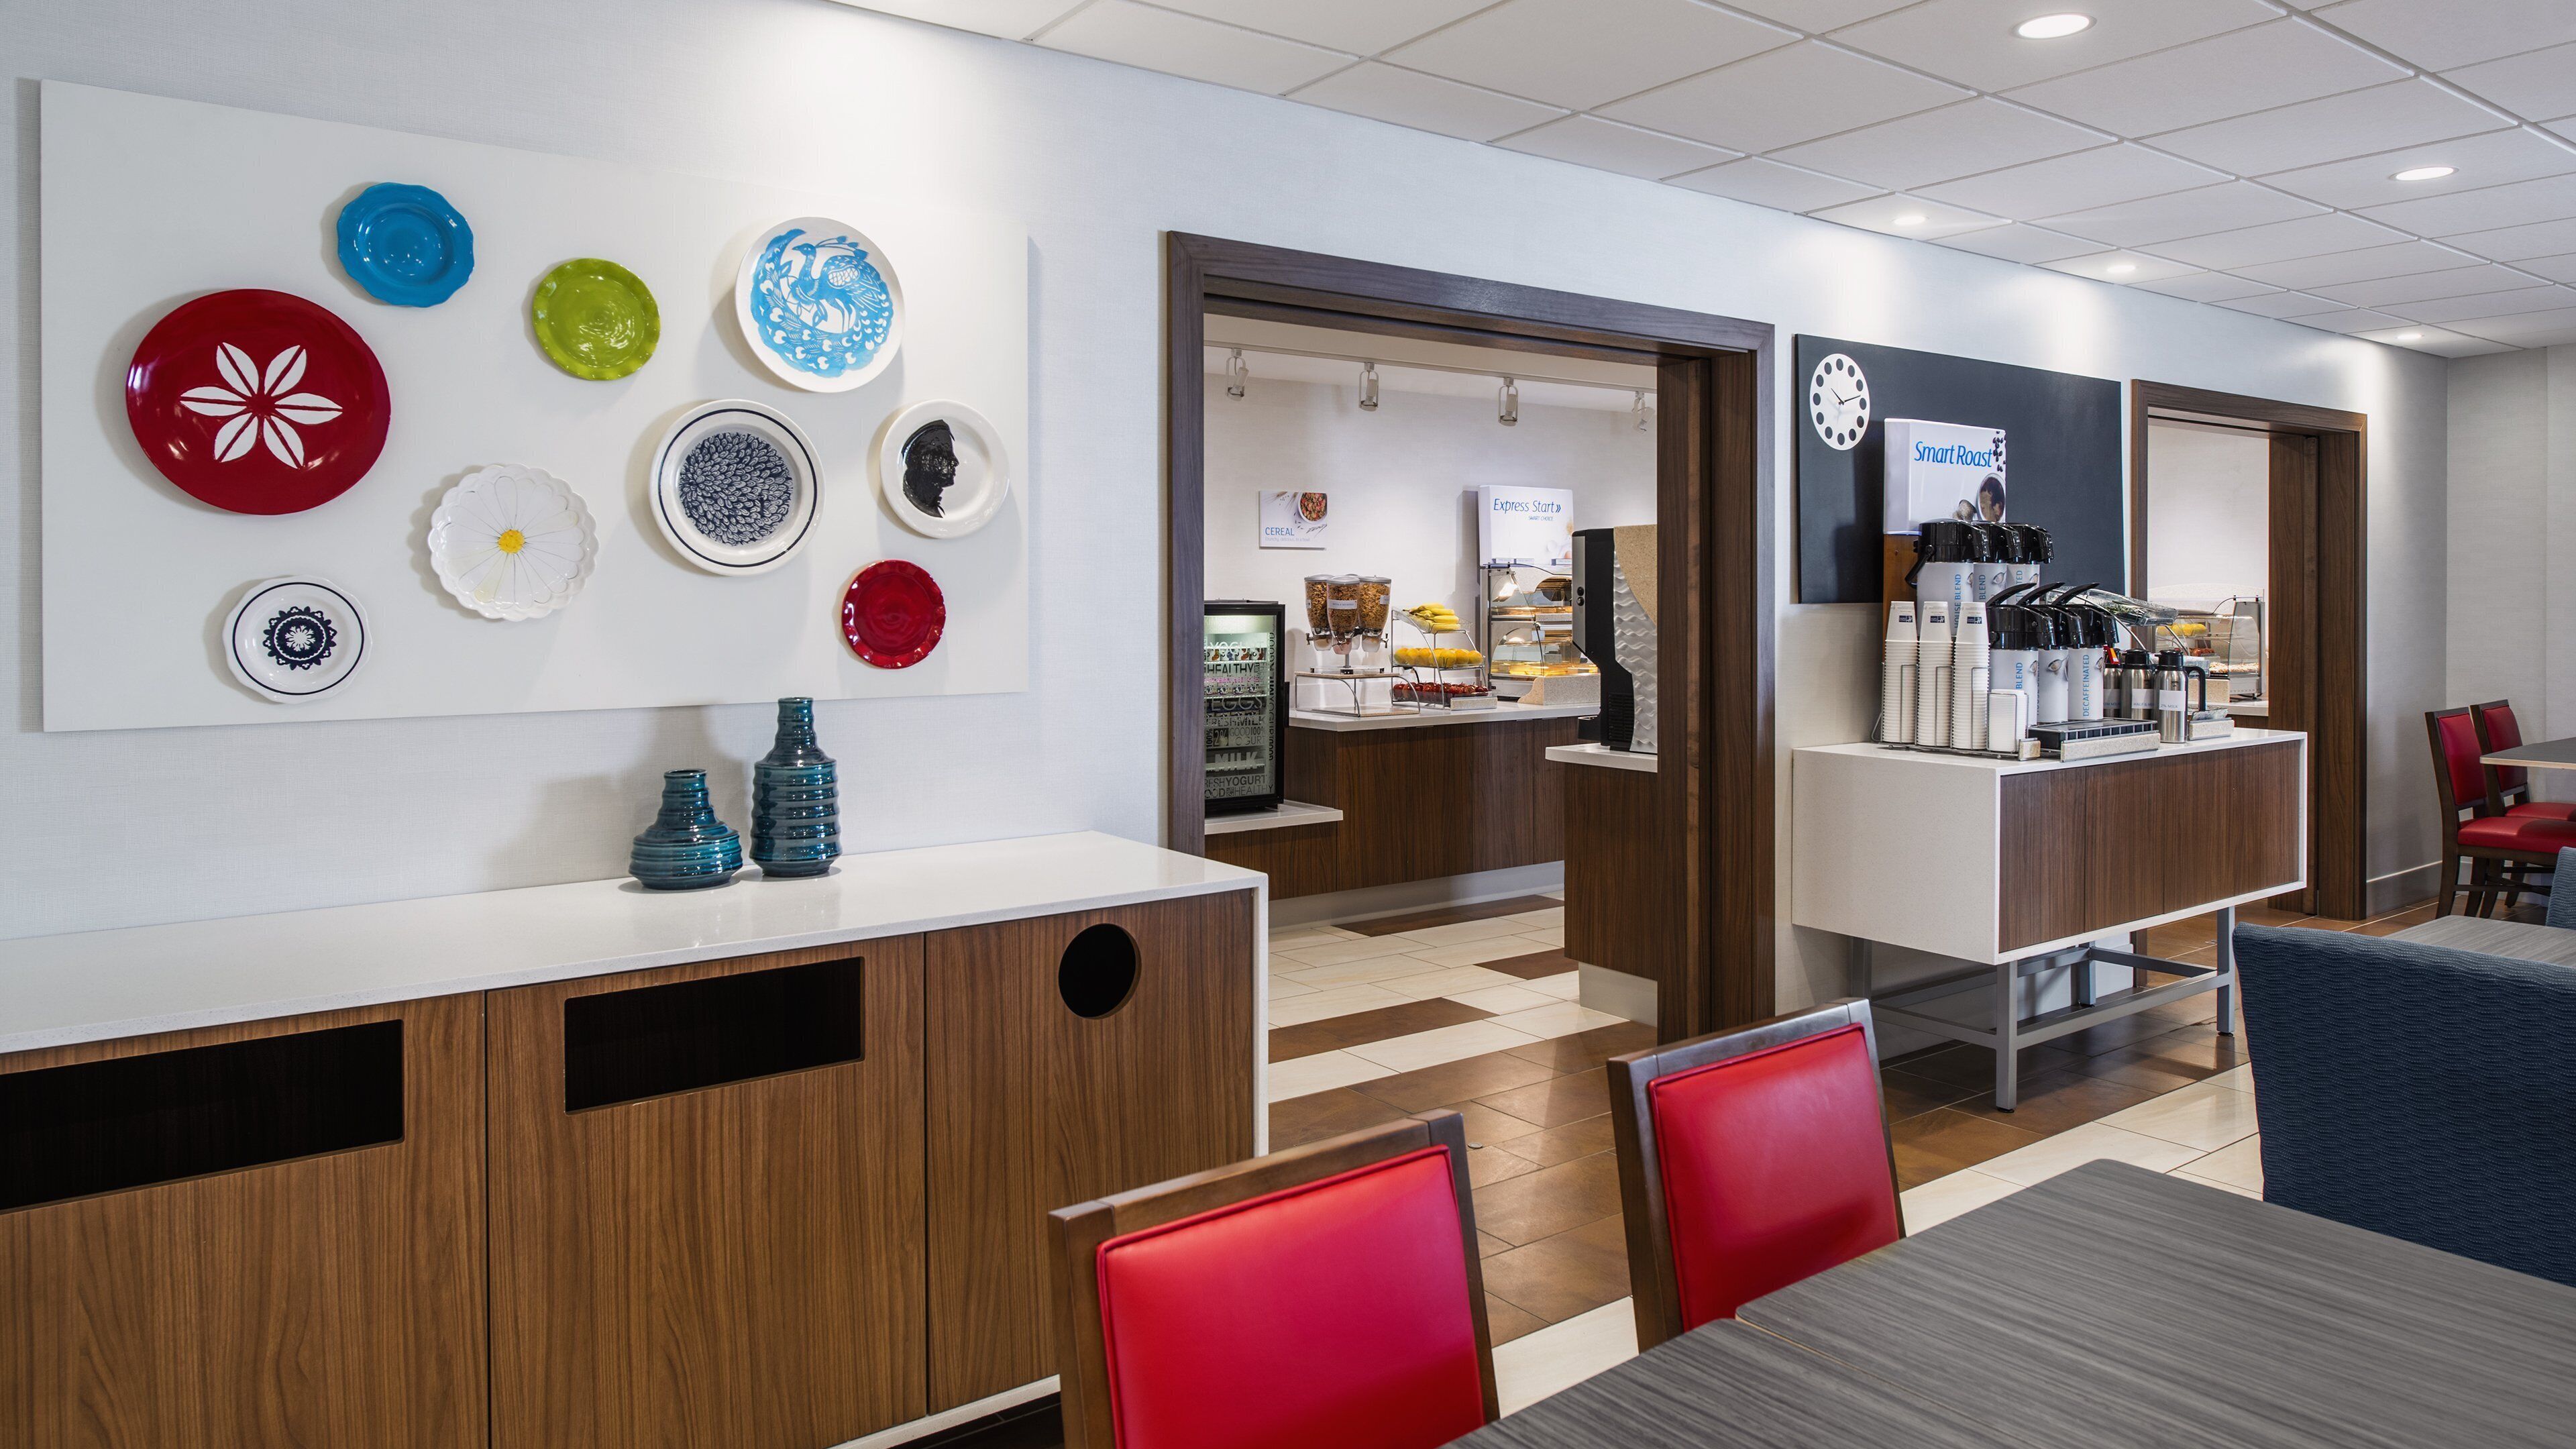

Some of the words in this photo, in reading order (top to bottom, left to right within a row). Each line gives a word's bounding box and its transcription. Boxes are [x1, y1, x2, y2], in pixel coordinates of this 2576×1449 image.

[1914, 441, 1955, 464] Smart
[1956, 445, 1992, 468] Roast
[1493, 498, 1529, 514] Express
[1532, 500, 1554, 513] Start
[1265, 527, 1295, 536] CEREAL
[1208, 663, 1254, 674] HEALTHY
[2015, 662, 2023, 689] BLEND
[1212, 694, 1263, 711] EGGS
[1229, 736, 1266, 746] OGURT
[1215, 751, 1258, 770] MILK
[1226, 774, 1266, 786] YOGURT
[1204, 788, 1226, 798] OOD
